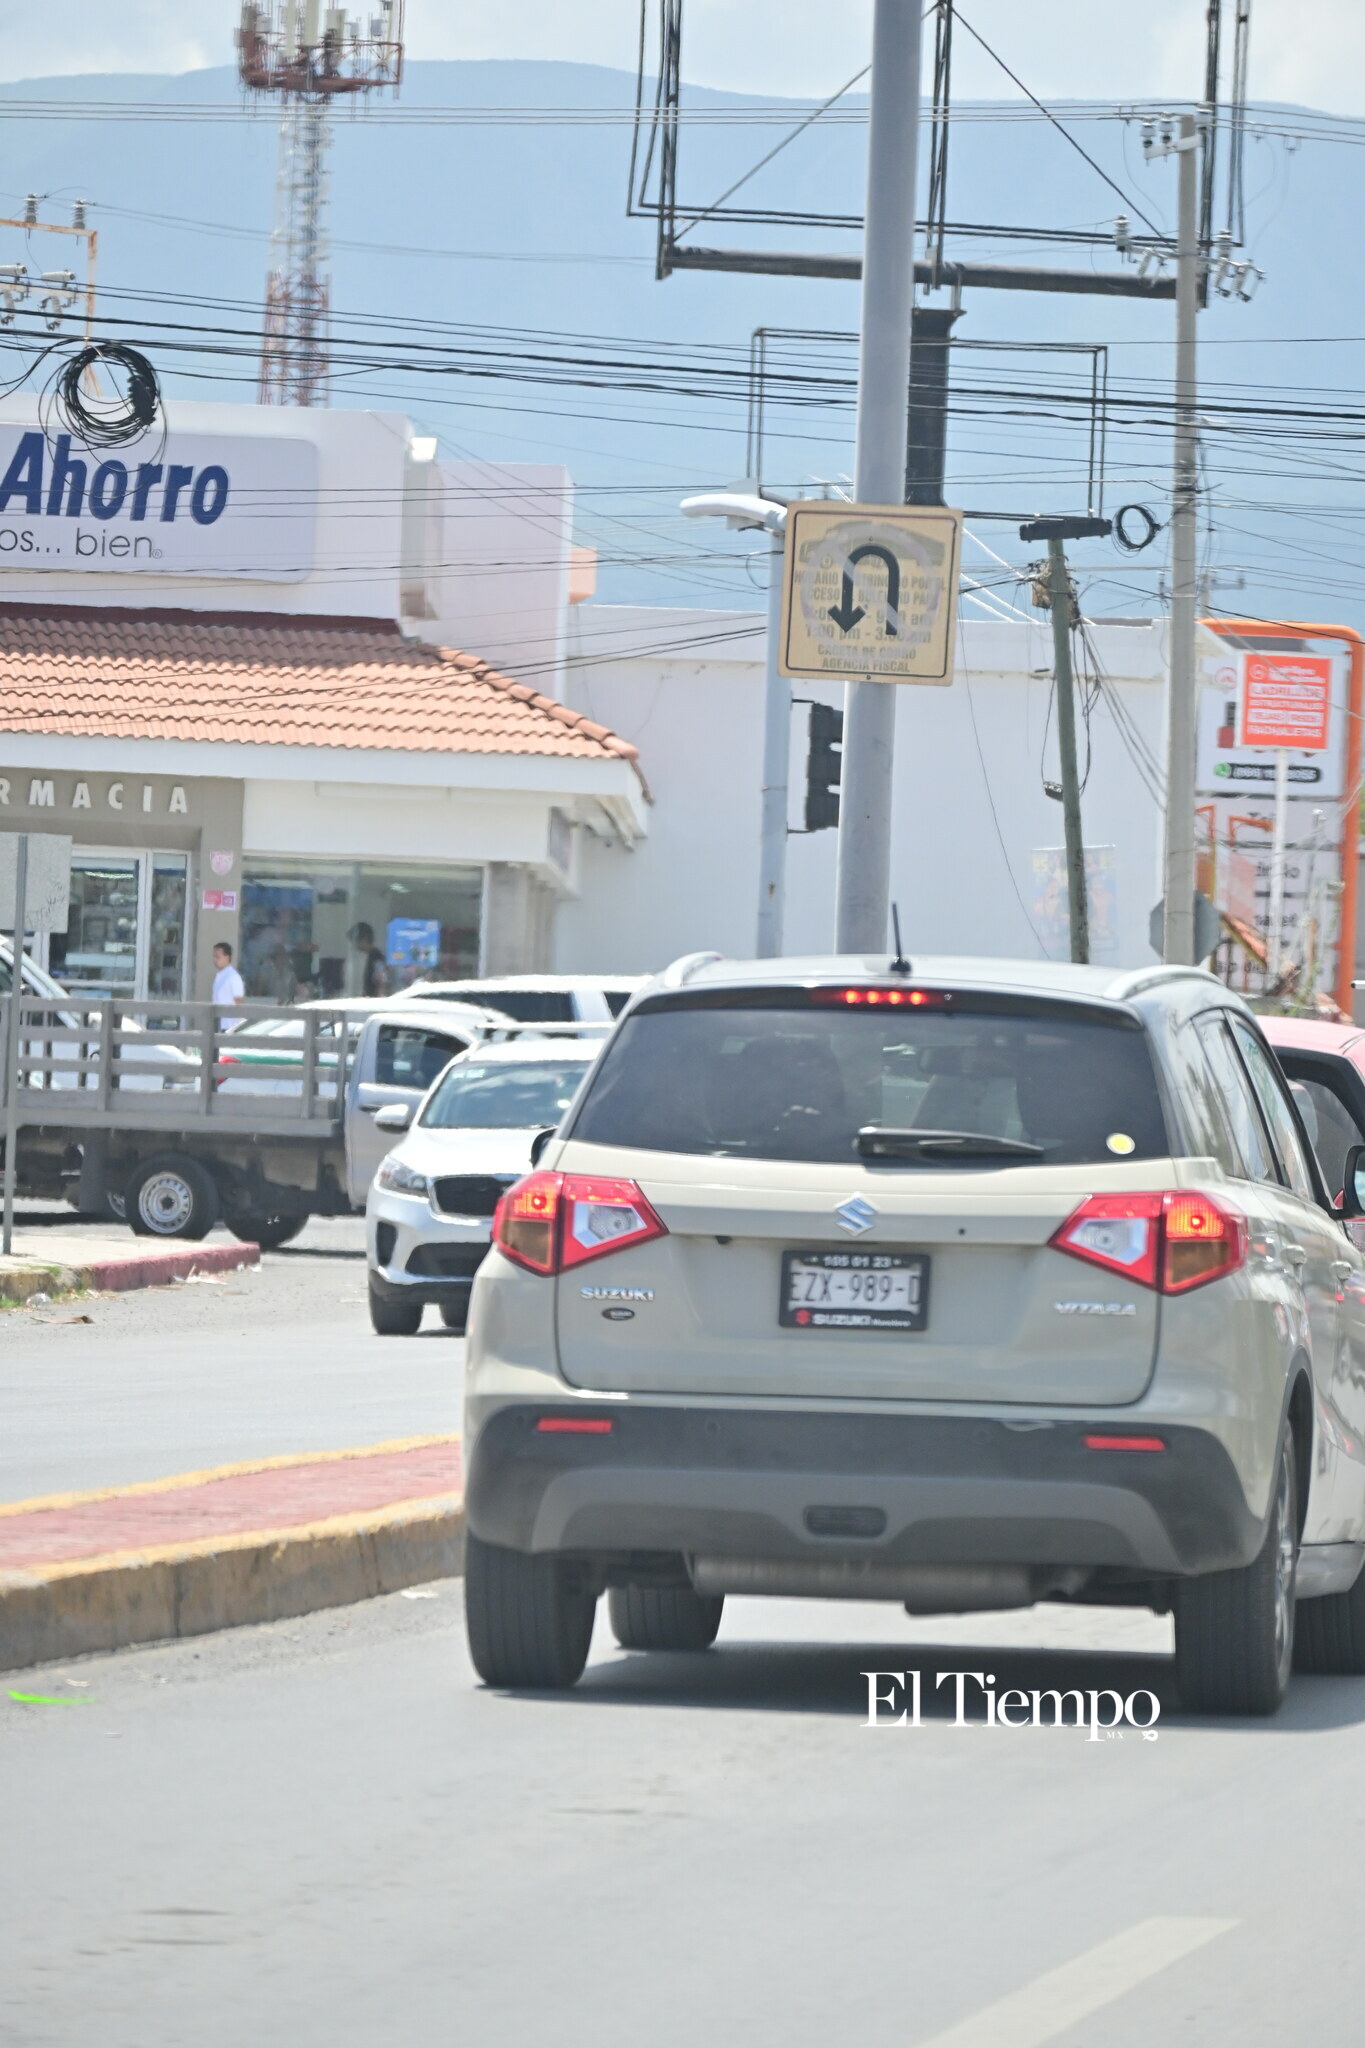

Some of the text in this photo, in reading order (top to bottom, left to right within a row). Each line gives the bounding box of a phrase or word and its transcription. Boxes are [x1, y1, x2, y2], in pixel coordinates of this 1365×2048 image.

[0, 432, 229, 525] Ahorro
[580, 1286, 655, 1302] SUZUKI
[812, 1313, 871, 1326] SUZUKI
